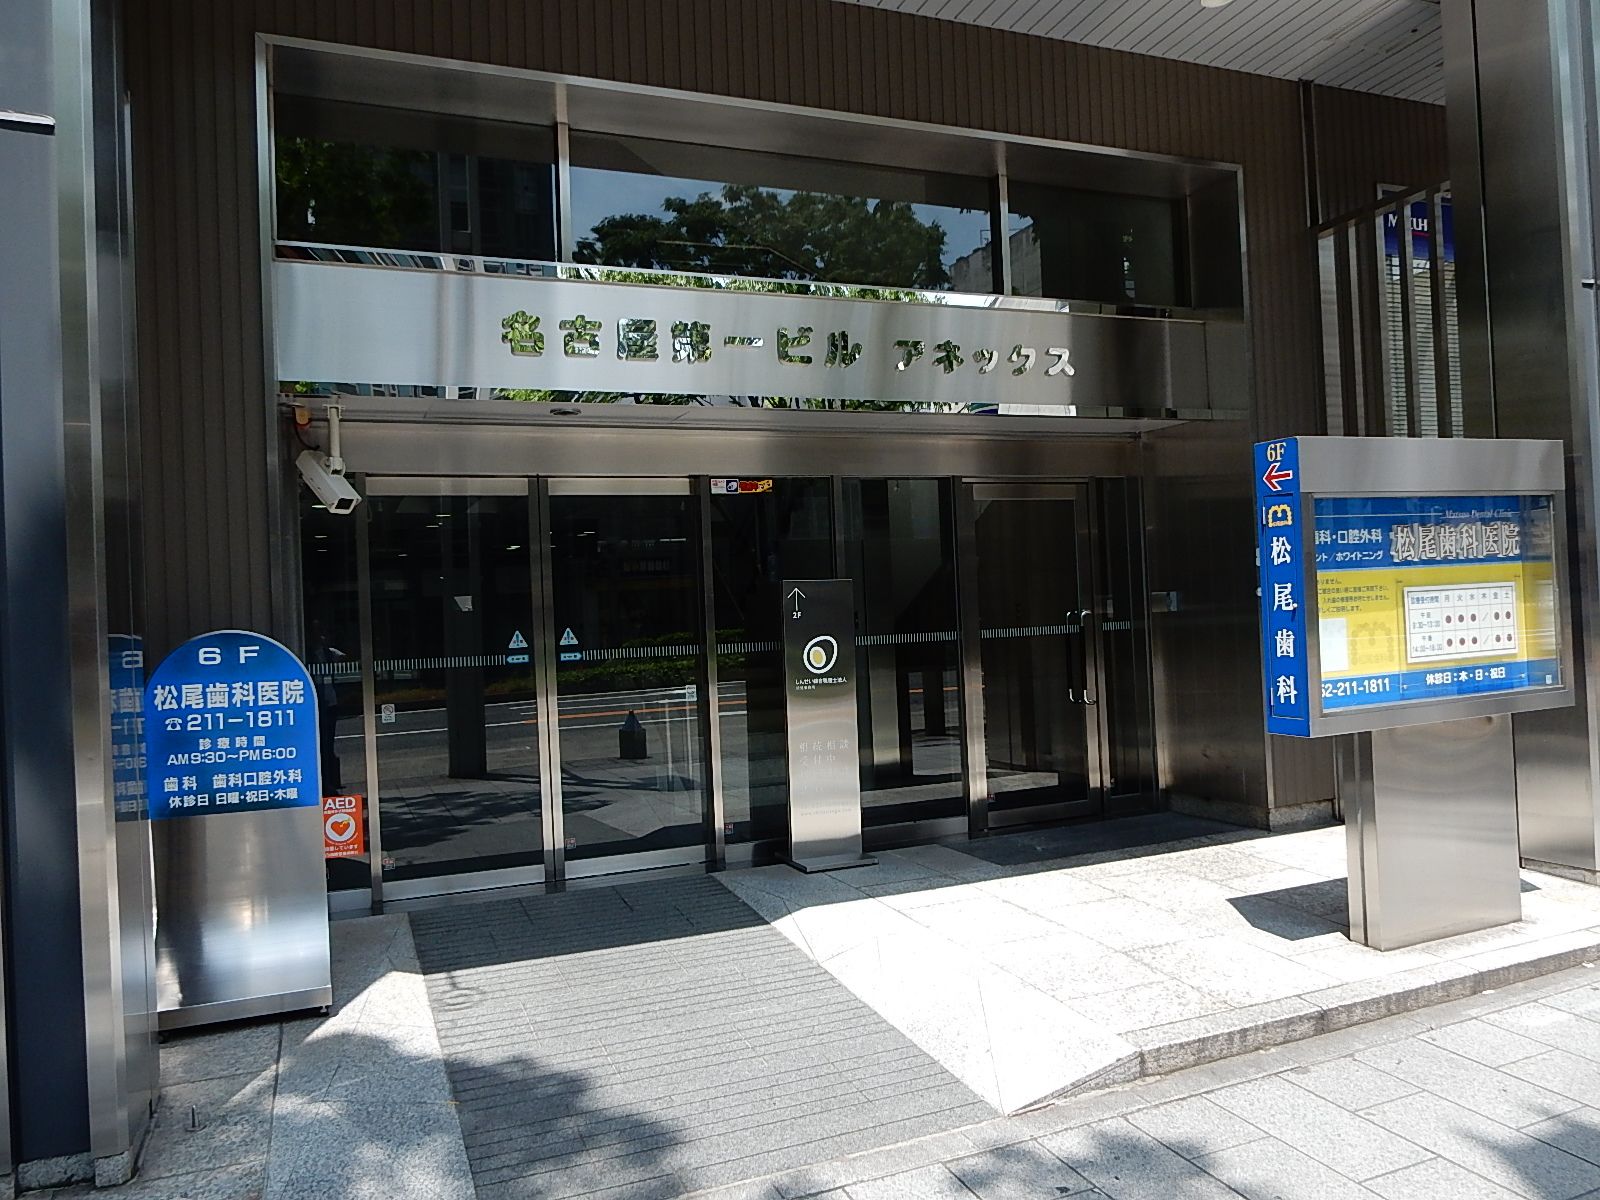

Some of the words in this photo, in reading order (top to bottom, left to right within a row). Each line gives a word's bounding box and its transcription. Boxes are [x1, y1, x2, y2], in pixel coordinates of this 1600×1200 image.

[501, 308, 863, 369] 名古屋第一ビル
[893, 338, 1077, 378] アネックス
[1266, 442, 1287, 461] 6F
[1394, 522, 1521, 561] 松尾歯科医院
[1444, 594, 1450, 602] 月
[792, 611, 802, 619] 2F
[1270, 536, 1298, 705] 松尾歯科
[154, 679, 305, 711] 松尾歯科医院
[199, 736, 266, 750] 診療時間
[164, 774, 197, 792] 歯科
[212, 769, 302, 789] 歯科口腔外科
[169, 792, 209, 809] 休診日
[324, 797, 356, 811] AED
